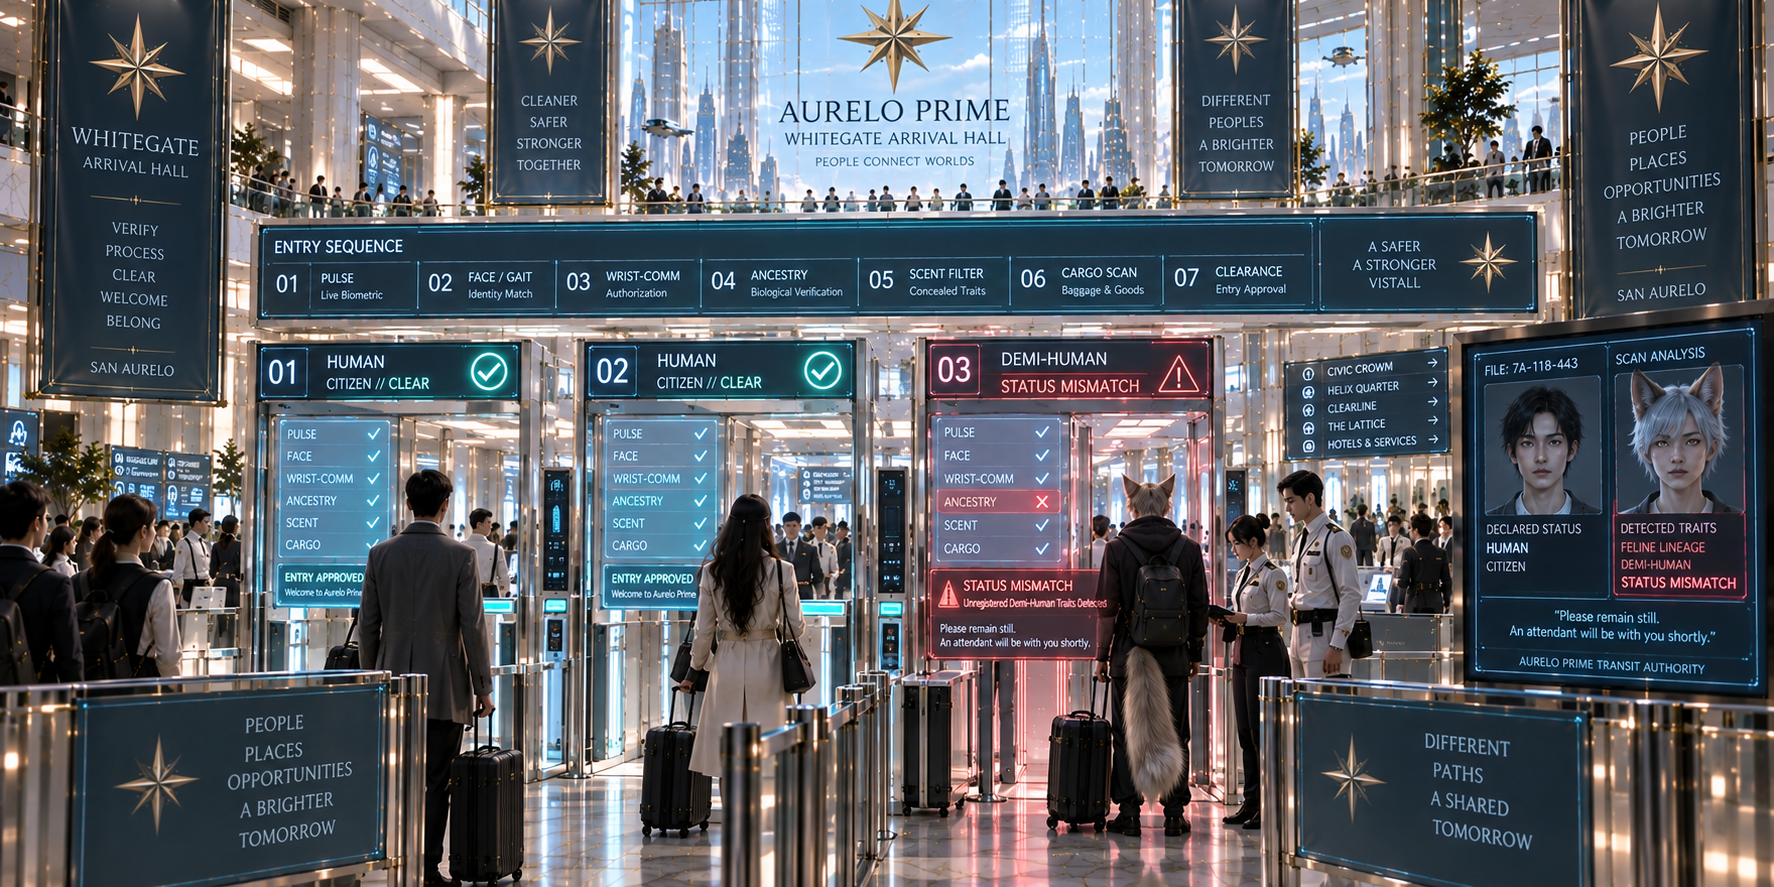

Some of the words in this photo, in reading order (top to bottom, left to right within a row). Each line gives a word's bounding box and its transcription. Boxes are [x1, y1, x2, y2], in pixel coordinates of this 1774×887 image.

[520, 94, 577, 106] CLEANER
[1202, 94, 1270, 106] DIFFERENT
[778, 99, 903, 122] AURELO
[916, 99, 1010, 121] PRIME
[530, 116, 567, 127] SAFER
[1209, 116, 1263, 128] PEOPLES
[71, 126, 198, 156] WHITEGATE
[784, 131, 882, 145] WHITEGATE
[887, 131, 958, 145] ARRIVAL
[964, 130, 1006, 144] HALL
[1630, 124, 1686, 145] PEOPLE
[516, 137, 581, 149] STRONGER
[1198, 139, 1208, 150] A
[1212, 138, 1273, 150] BRIGHTER
[82, 156, 146, 174] ARRIVAL
[151, 162, 188, 178] HALL
[516, 159, 581, 170] TOGETHER
[815, 156, 858, 166] PEOPLE
[863, 156, 920, 166] CONNECT
[924, 155, 974, 166] WORLDS
[1198, 160, 1274, 172] TOMORROW
[1630, 150, 1686, 171] PLACES
[1603, 171, 1720, 199] OPPORTUNITIES
[1617, 210, 1627, 223] A
[1632, 201, 1704, 222] BRIGHTER
[112, 221, 158, 236] VERIFY
[1616, 227, 1706, 249] TOMORROW
[106, 244, 164, 260] PROCESS
[274, 240, 321, 253] ENTRY
[325, 239, 402, 254] SEQUENCE
[1368, 241, 1377, 252] A
[1381, 240, 1420, 252] SAFER
[1352, 259, 1362, 270] A
[1366, 258, 1436, 270] STRONGER
[112, 268, 155, 283] CLEAR
[321, 272, 353, 283] PULSE
[468, 271, 495, 282] FACE
[506, 271, 532, 282] GAIT
[606, 270, 680, 281] WRIST-COMM
[750, 269, 808, 280] ANCESTRY
[909, 268, 945, 279] SCENT
[948, 268, 983, 278] FILTER
[1021, 268, 1045, 287] 06
[1061, 267, 1102, 278] CARGO
[1106, 266, 1136, 277] SCAN
[1174, 268, 1199, 286] 07
[1215, 265, 1282, 277] CLEARANCE
[276, 274, 296, 293] 01
[428, 273, 452, 291] 02
[566, 272, 590, 290] 03
[711, 271, 735, 290] 04
[869, 270, 893, 289] 05
[1368, 276, 1420, 288] VISTALL
[320, 290, 338, 299] Live
[341, 289, 383, 299] Biometric
[468, 288, 502, 301] Identity
[505, 288, 532, 298] Match
[605, 288, 667, 297] Authorization
[751, 287, 792, 299] Biological
[794, 286, 843, 296] Verification
[909, 285, 957, 296] Concealed
[960, 285, 986, 295] Traits
[1062, 285, 1101, 297] Baggage
[1114, 284, 1144, 294] Goods
[1216, 284, 1241, 296] Entry
[1243, 283, 1286, 295] Approval
[1617, 287, 1644, 301] SAN
[1648, 282, 1705, 299] AURELO
[100, 290, 167, 306] WELCOME
[107, 314, 160, 329] BELONG
[327, 354, 384, 368] HUMAN
[658, 353, 715, 367] HUMAN
[1002, 351, 1106, 366] DEMI-HUMAN
[1615, 352, 1646, 365] SCAN
[1650, 346, 1705, 362] ANALYSIS
[90, 361, 117, 373] SAN
[121, 363, 174, 376] AURELO
[268, 359, 295, 384] 01
[596, 357, 628, 383] 02
[938, 356, 970, 382] 03
[1327, 365, 1352, 376] CIVIC
[1484, 363, 1508, 376] FILE:
[1512, 357, 1578, 373] 7A-118-443
[326, 377, 371, 389] CITIZEN
[388, 376, 429, 389] CLEAR
[656, 376, 702, 389] CITIZEN
[720, 376, 761, 388] CLEAR
[1001, 379, 1055, 393] STATUS
[1061, 379, 1139, 393] MISMATCH
[1328, 384, 1353, 395] HELIX
[1355, 380, 1399, 393] QUARTER
[1327, 400, 1376, 413] CLEARLINE
[1328, 421, 1345, 431] THE
[1348, 418, 1385, 430] LATTICE
[287, 428, 316, 439] PULSE
[613, 428, 642, 438] PULSE
[944, 426, 974, 437] PULSE
[1328, 438, 1362, 449] HOTELS
[1374, 435, 1416, 447] SERVICES
[287, 450, 312, 461] FACE
[944, 450, 970, 460] FACE
[286, 473, 353, 483] WRIST-COMM
[613, 473, 680, 483] WRIST-COMM
[944, 473, 1013, 484] WRIST-COMM
[285, 495, 337, 506] ANCESTRY
[612, 495, 663, 506] ANCESTRY
[944, 496, 996, 507] ANCESTRY
[286, 517, 318, 528] SCENT
[944, 519, 978, 530] SCENT
[1486, 523, 1539, 534] DECLARED
[1542, 523, 1581, 534] STATUS
[1620, 522, 1674, 533] DETECTED
[1678, 522, 1716, 533] TRAITS
[285, 539, 320, 550] CARGO
[944, 542, 980, 554] CARGO
[1486, 542, 1528, 554] HUMAN
[1621, 541, 1655, 552] FELINE
[1659, 541, 1705, 553] LINEAGE
[1486, 560, 1525, 572] CITIZEN
[1621, 559, 1690, 570] DEMI-HUMAN
[963, 579, 1006, 591] STATUS
[1010, 579, 1072, 591] MISMATCH
[1621, 576, 1666, 588] STATUS
[1670, 576, 1736, 589] MISMATCH
[1596, 611, 1633, 623] remain
[1637, 611, 1659, 623] still.
[1509, 625, 1523, 636] An
[1526, 626, 1577, 638] attendant
[1580, 627, 1597, 638] will
[1601, 627, 1614, 639] be
[1617, 628, 1640, 640] with
[1643, 632, 1664, 643] you
[1518, 656, 1559, 667] AURELO
[1562, 658, 1593, 669] PRIME
[1596, 659, 1640, 671] TRANSIT
[1642, 662, 1705, 674] AUTHORITY
[245, 714, 303, 733] PEOPLE
[1425, 732, 1510, 757] DIFFERENT
[245, 741, 302, 762] PLACES
[227, 761, 352, 790] OPPORTUNITIES
[1433, 762, 1483, 783] PATHS
[240, 802, 251, 818] A
[257, 791, 333, 816] BRIGHTER
[1430, 790, 1441, 806] A
[1445, 792, 1508, 816] SHARED
[238, 819, 335, 848] TOMORROW
[1432, 819, 1532, 850] TOMORROW
